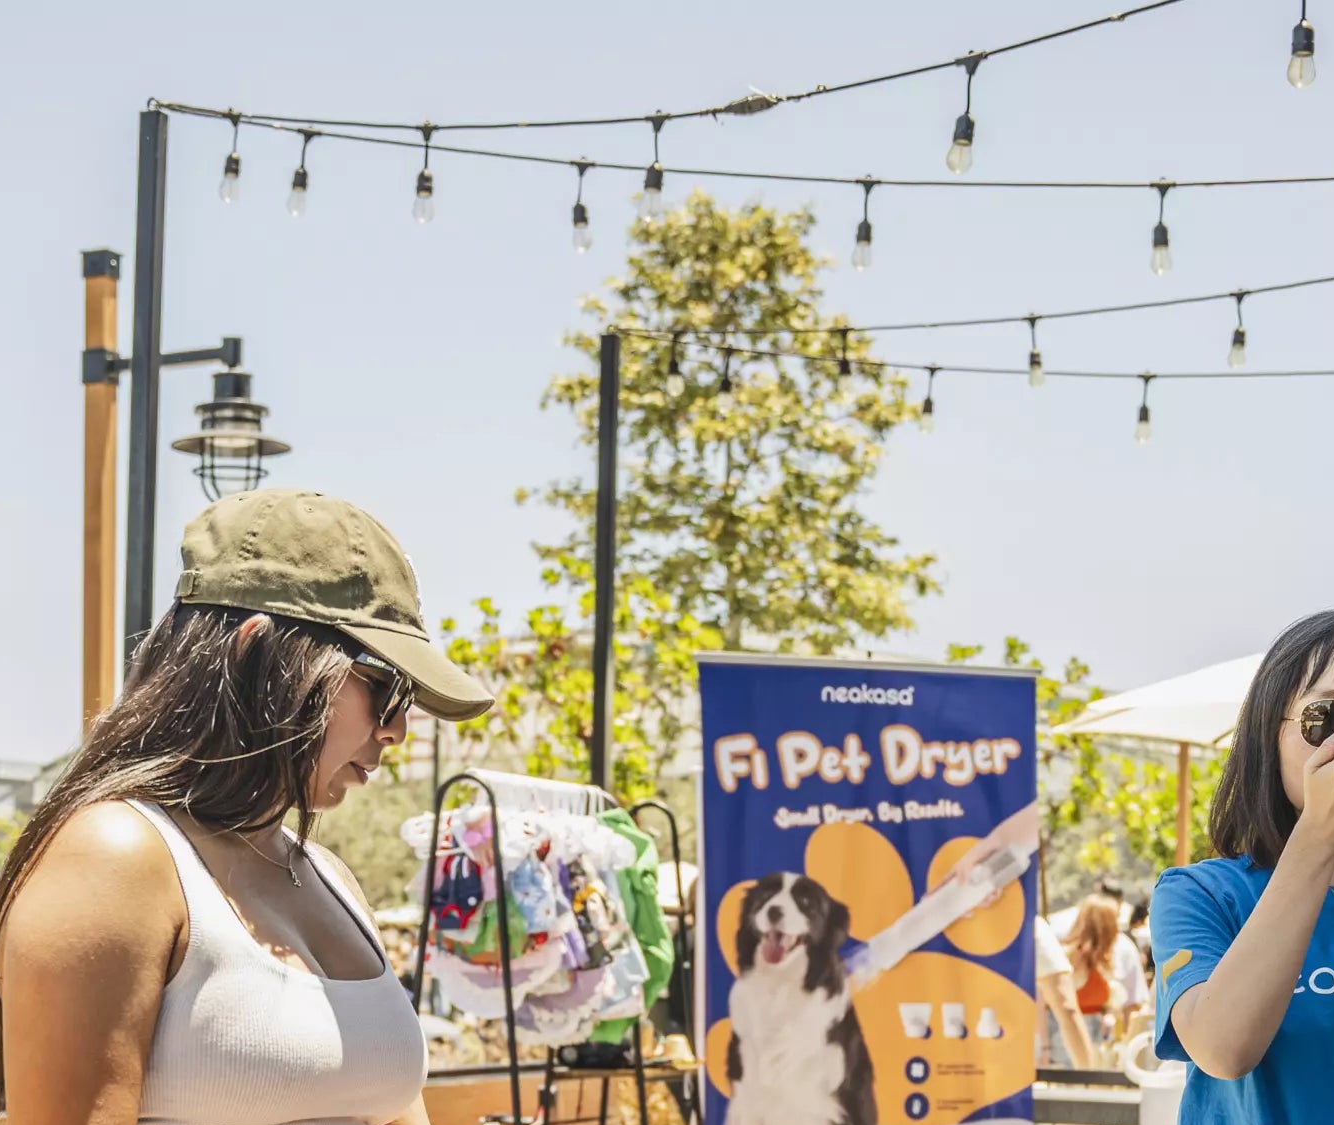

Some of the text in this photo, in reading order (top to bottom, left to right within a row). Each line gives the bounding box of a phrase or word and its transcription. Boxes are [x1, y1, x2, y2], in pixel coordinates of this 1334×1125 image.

[821, 683, 915, 706] neakasa
[776, 730, 871, 789] Pet
[880, 723, 1021, 787] Dryer
